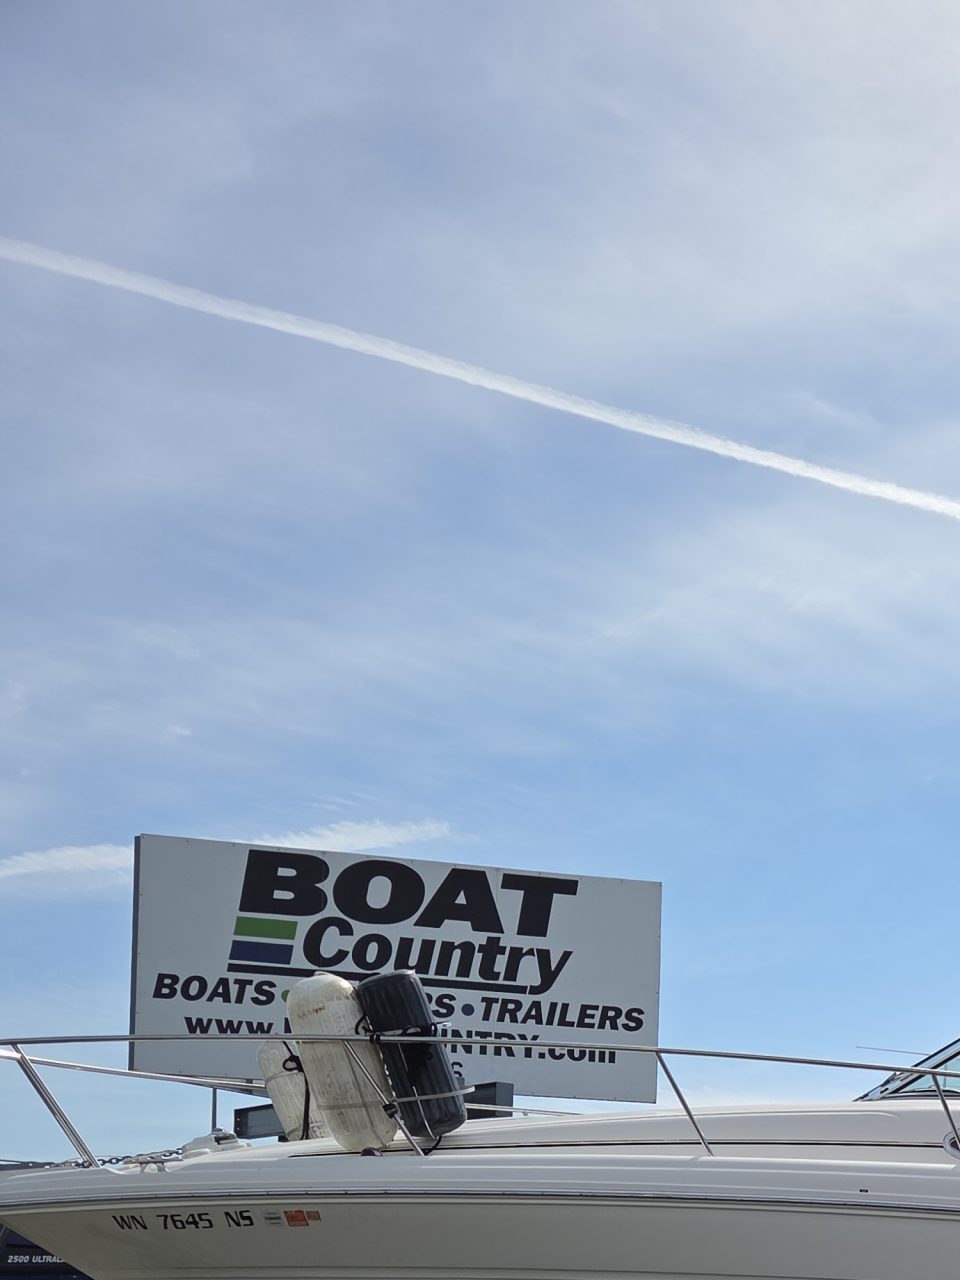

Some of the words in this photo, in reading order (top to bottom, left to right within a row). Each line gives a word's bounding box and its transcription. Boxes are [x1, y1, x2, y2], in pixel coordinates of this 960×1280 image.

[239, 849, 579, 938] BOAT
[303, 916, 573, 995] Country
[152, 973, 277, 1006] BOATS
[480, 997, 645, 1032] TRAILERS
[112, 1215, 148, 1230] WN
[157, 1213, 214, 1230] 7645
[224, 1210, 254, 1228] NS
[7, 1255, 30, 1263] 2500
[31, 1255, 64, 1263] ULTRAL
